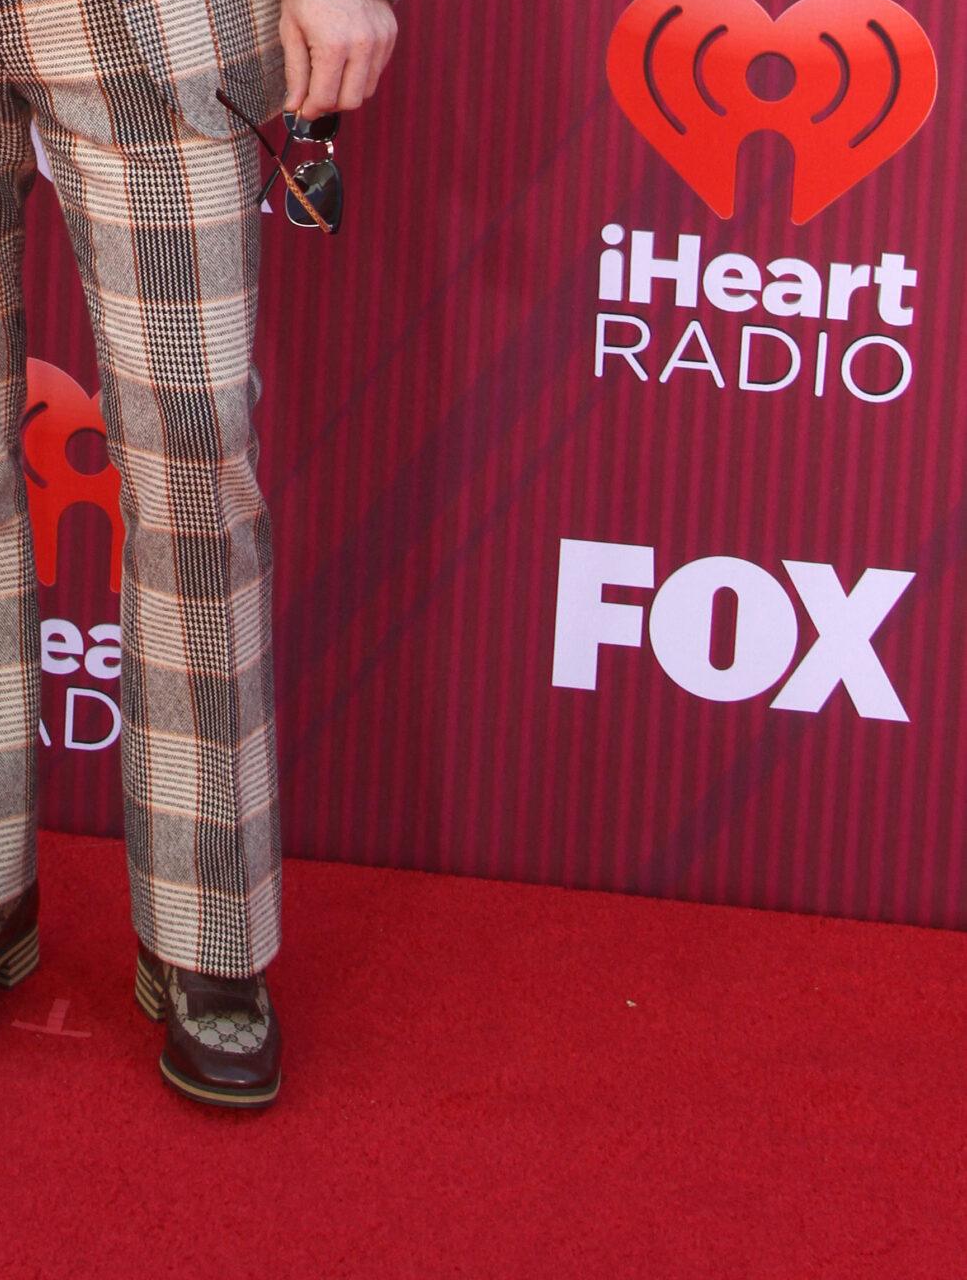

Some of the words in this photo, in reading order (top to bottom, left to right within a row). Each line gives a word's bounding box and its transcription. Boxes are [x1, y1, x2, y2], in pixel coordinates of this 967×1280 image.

[598, 223, 918, 327] iHeart
[594, 313, 914, 403] RADIO
[551, 538, 916, 723] FOX
